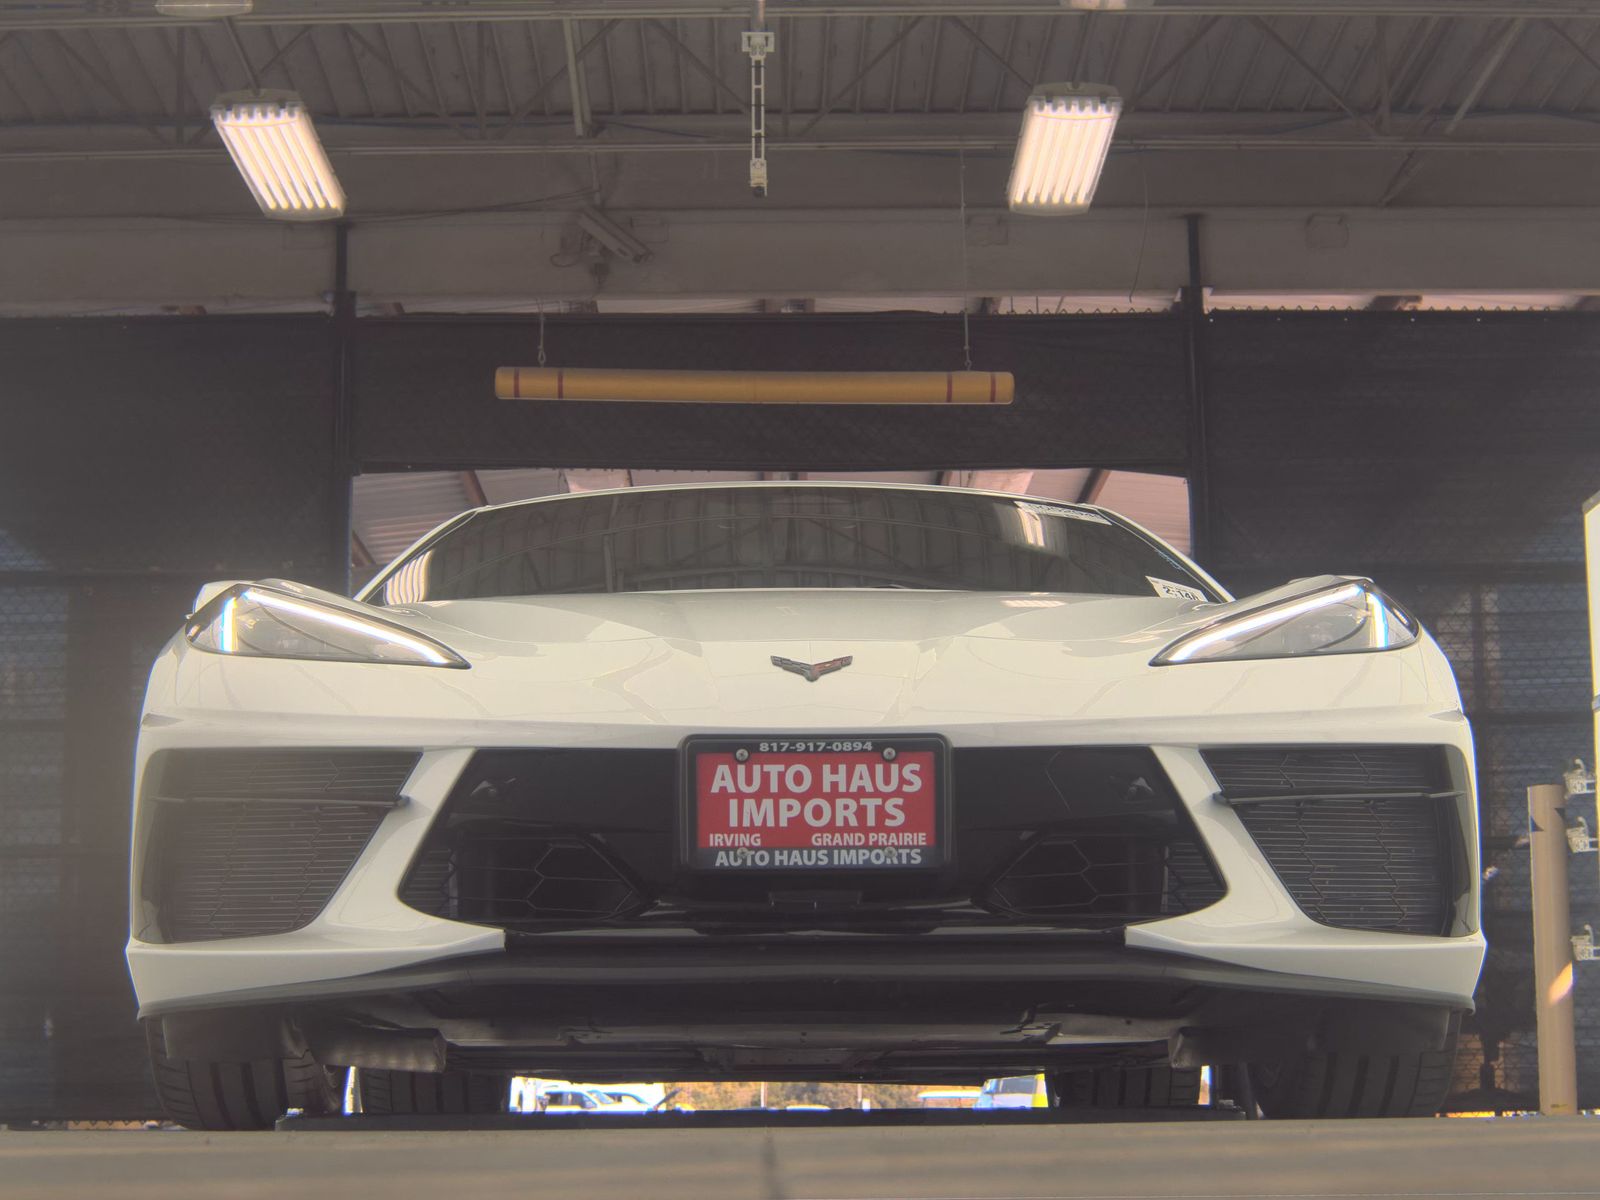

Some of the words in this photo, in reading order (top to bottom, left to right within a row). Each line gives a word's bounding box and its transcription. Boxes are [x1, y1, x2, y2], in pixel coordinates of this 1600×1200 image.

[759, 741, 873, 752] 817-917-0894
[710, 764, 812, 794] AUTO
[822, 763, 922, 793] HAUS
[729, 797, 906, 828] IMPORTS
[709, 833, 761, 847] IRVING
[811, 833, 866, 846] GRAND
[869, 832, 927, 846] PRAIRIE
[715, 850, 770, 867] AUTO
[774, 850, 829, 866] HAUS
